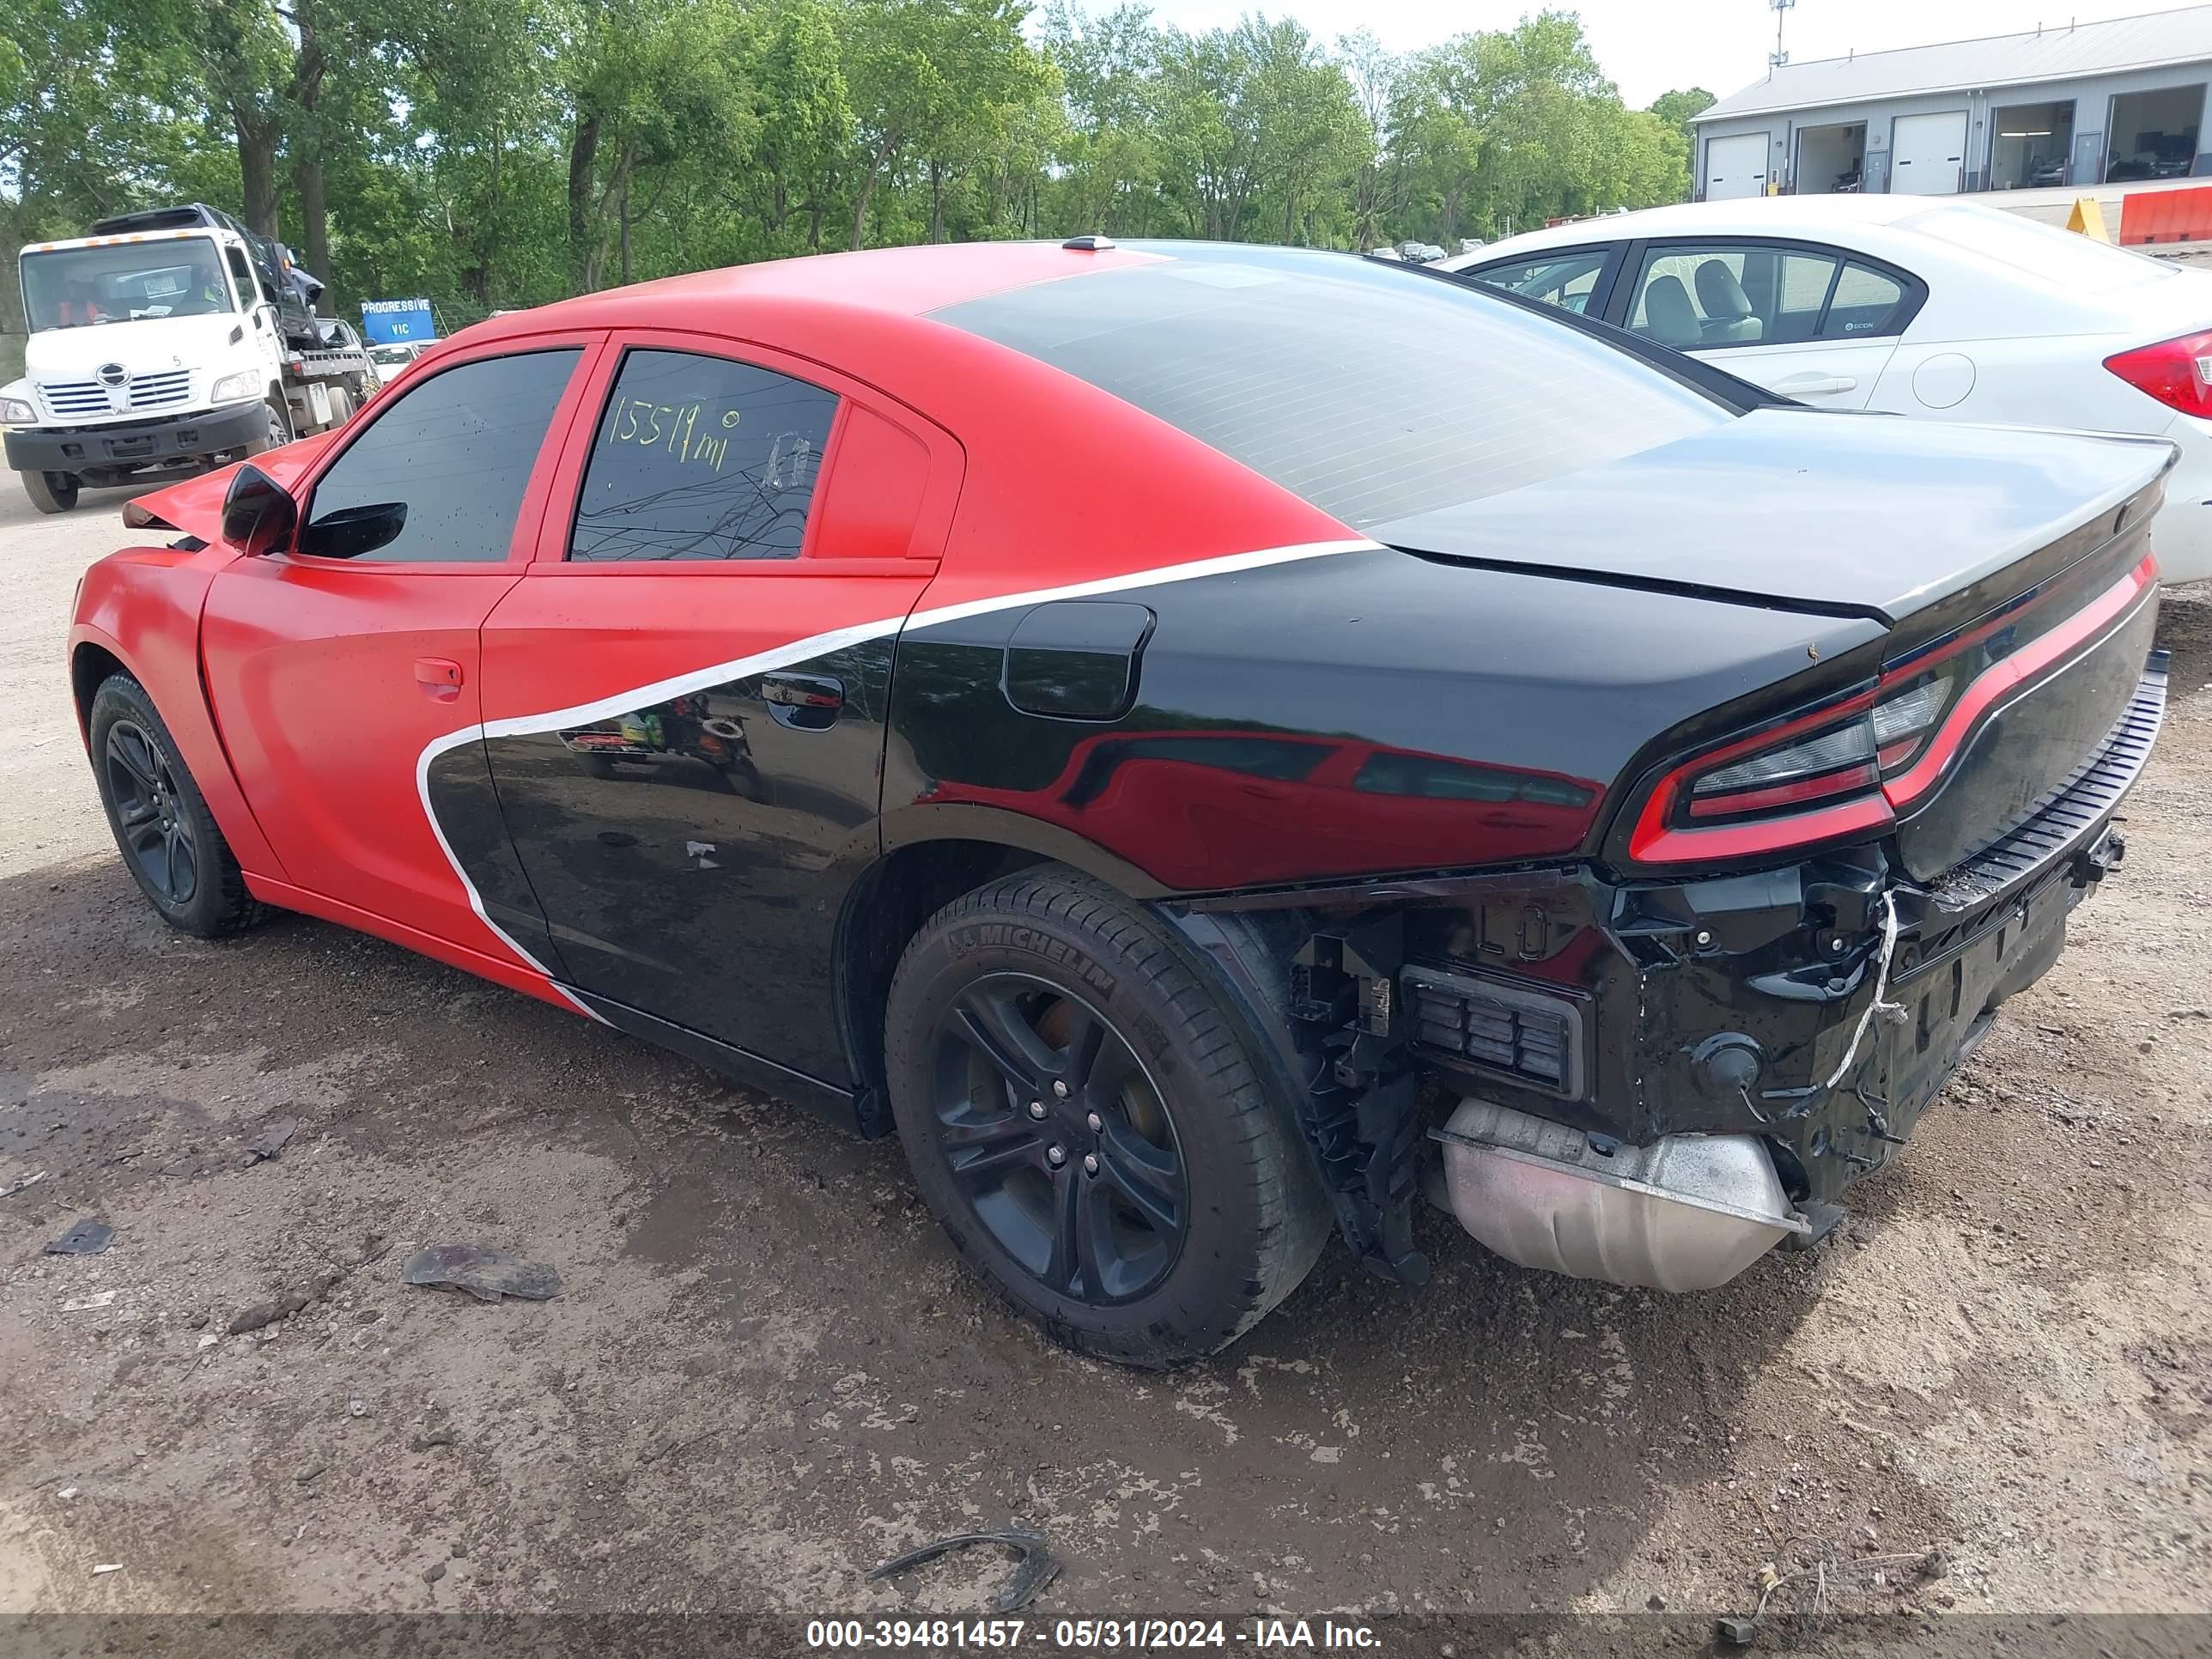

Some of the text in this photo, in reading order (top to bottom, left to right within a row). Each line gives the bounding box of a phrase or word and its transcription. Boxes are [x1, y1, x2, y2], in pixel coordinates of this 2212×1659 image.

[362, 298, 430, 314] PROGRESSIVE
[392, 323, 410, 336] VIC
[173, 356, 181, 367] 5
[980, 926, 1115, 990] MICHELIN
